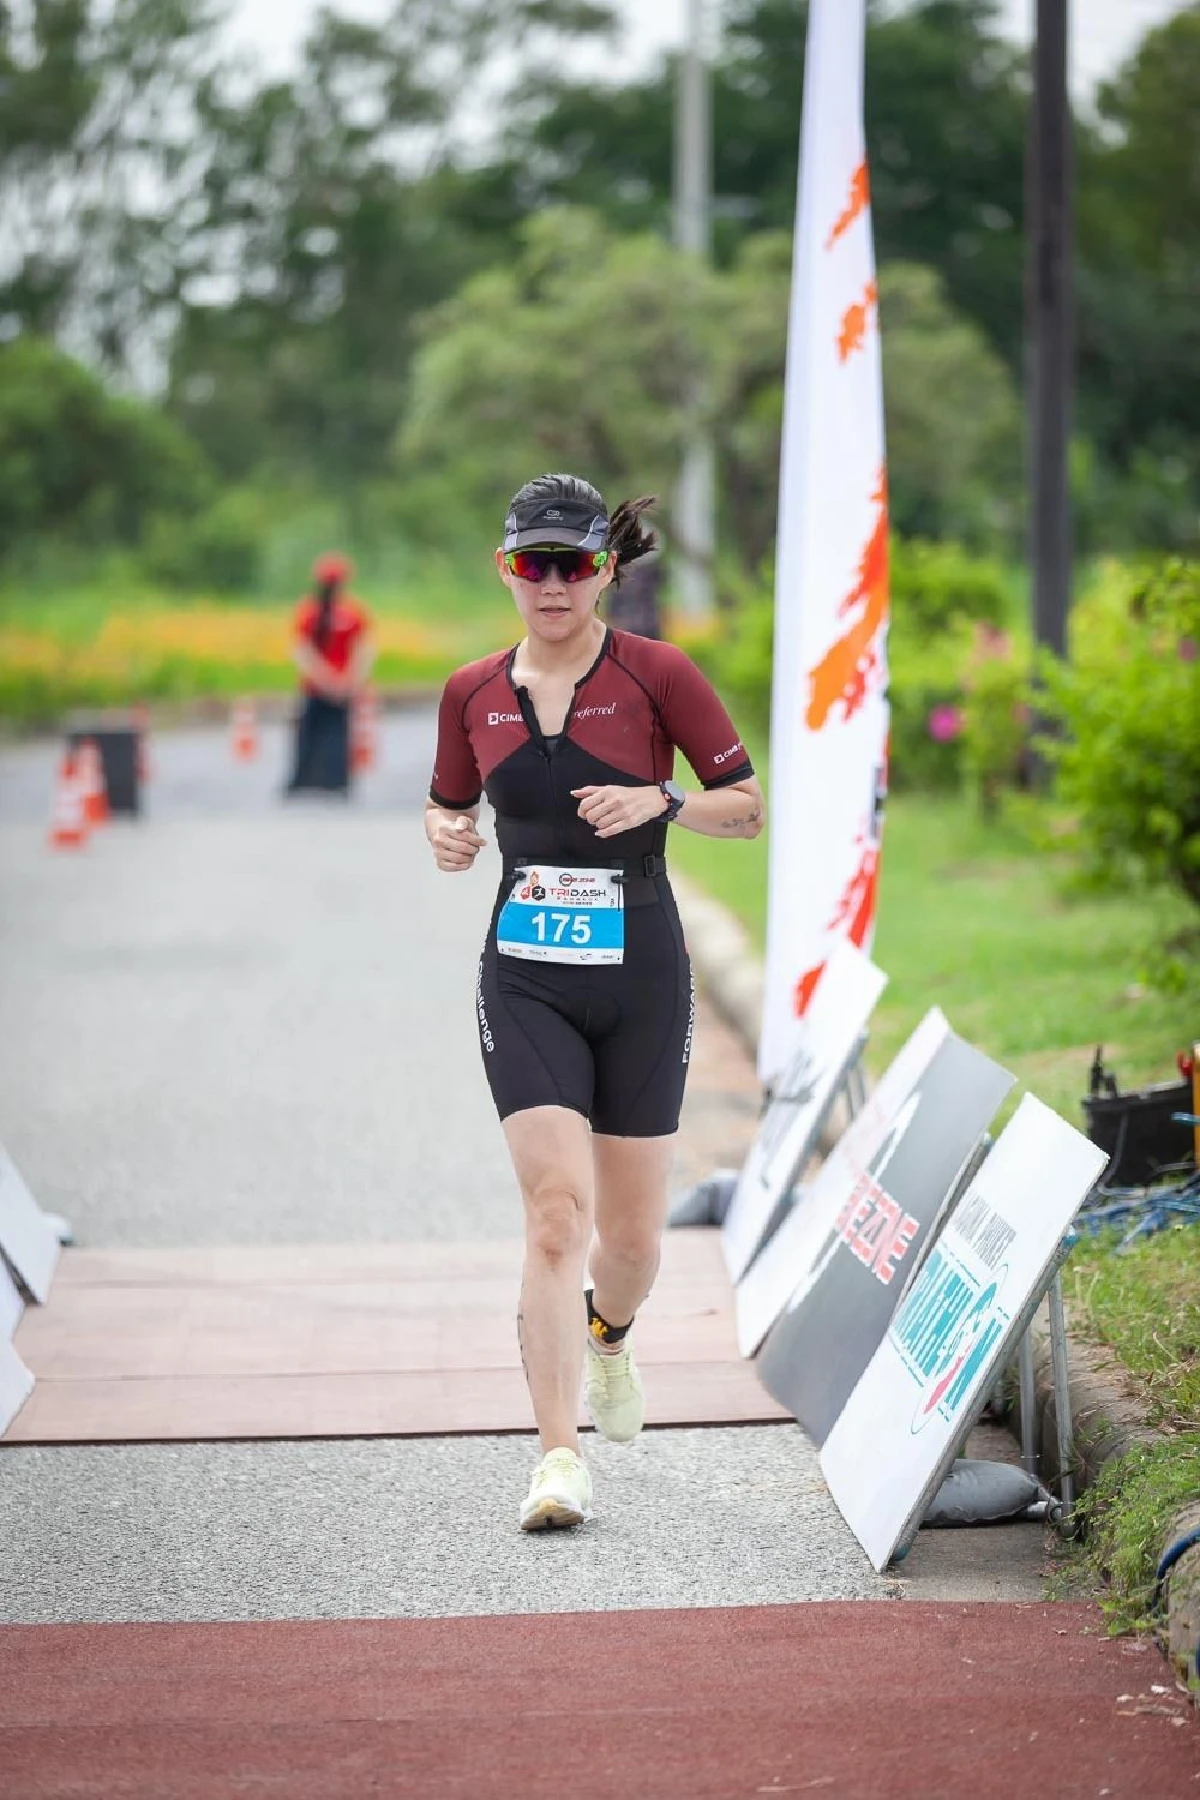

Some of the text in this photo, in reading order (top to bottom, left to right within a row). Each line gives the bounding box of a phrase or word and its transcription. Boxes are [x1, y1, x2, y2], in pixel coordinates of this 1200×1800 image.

[574, 702, 617, 720] referred
[549, 887, 607, 897] TRIDASH
[531, 911, 591, 944] 175
